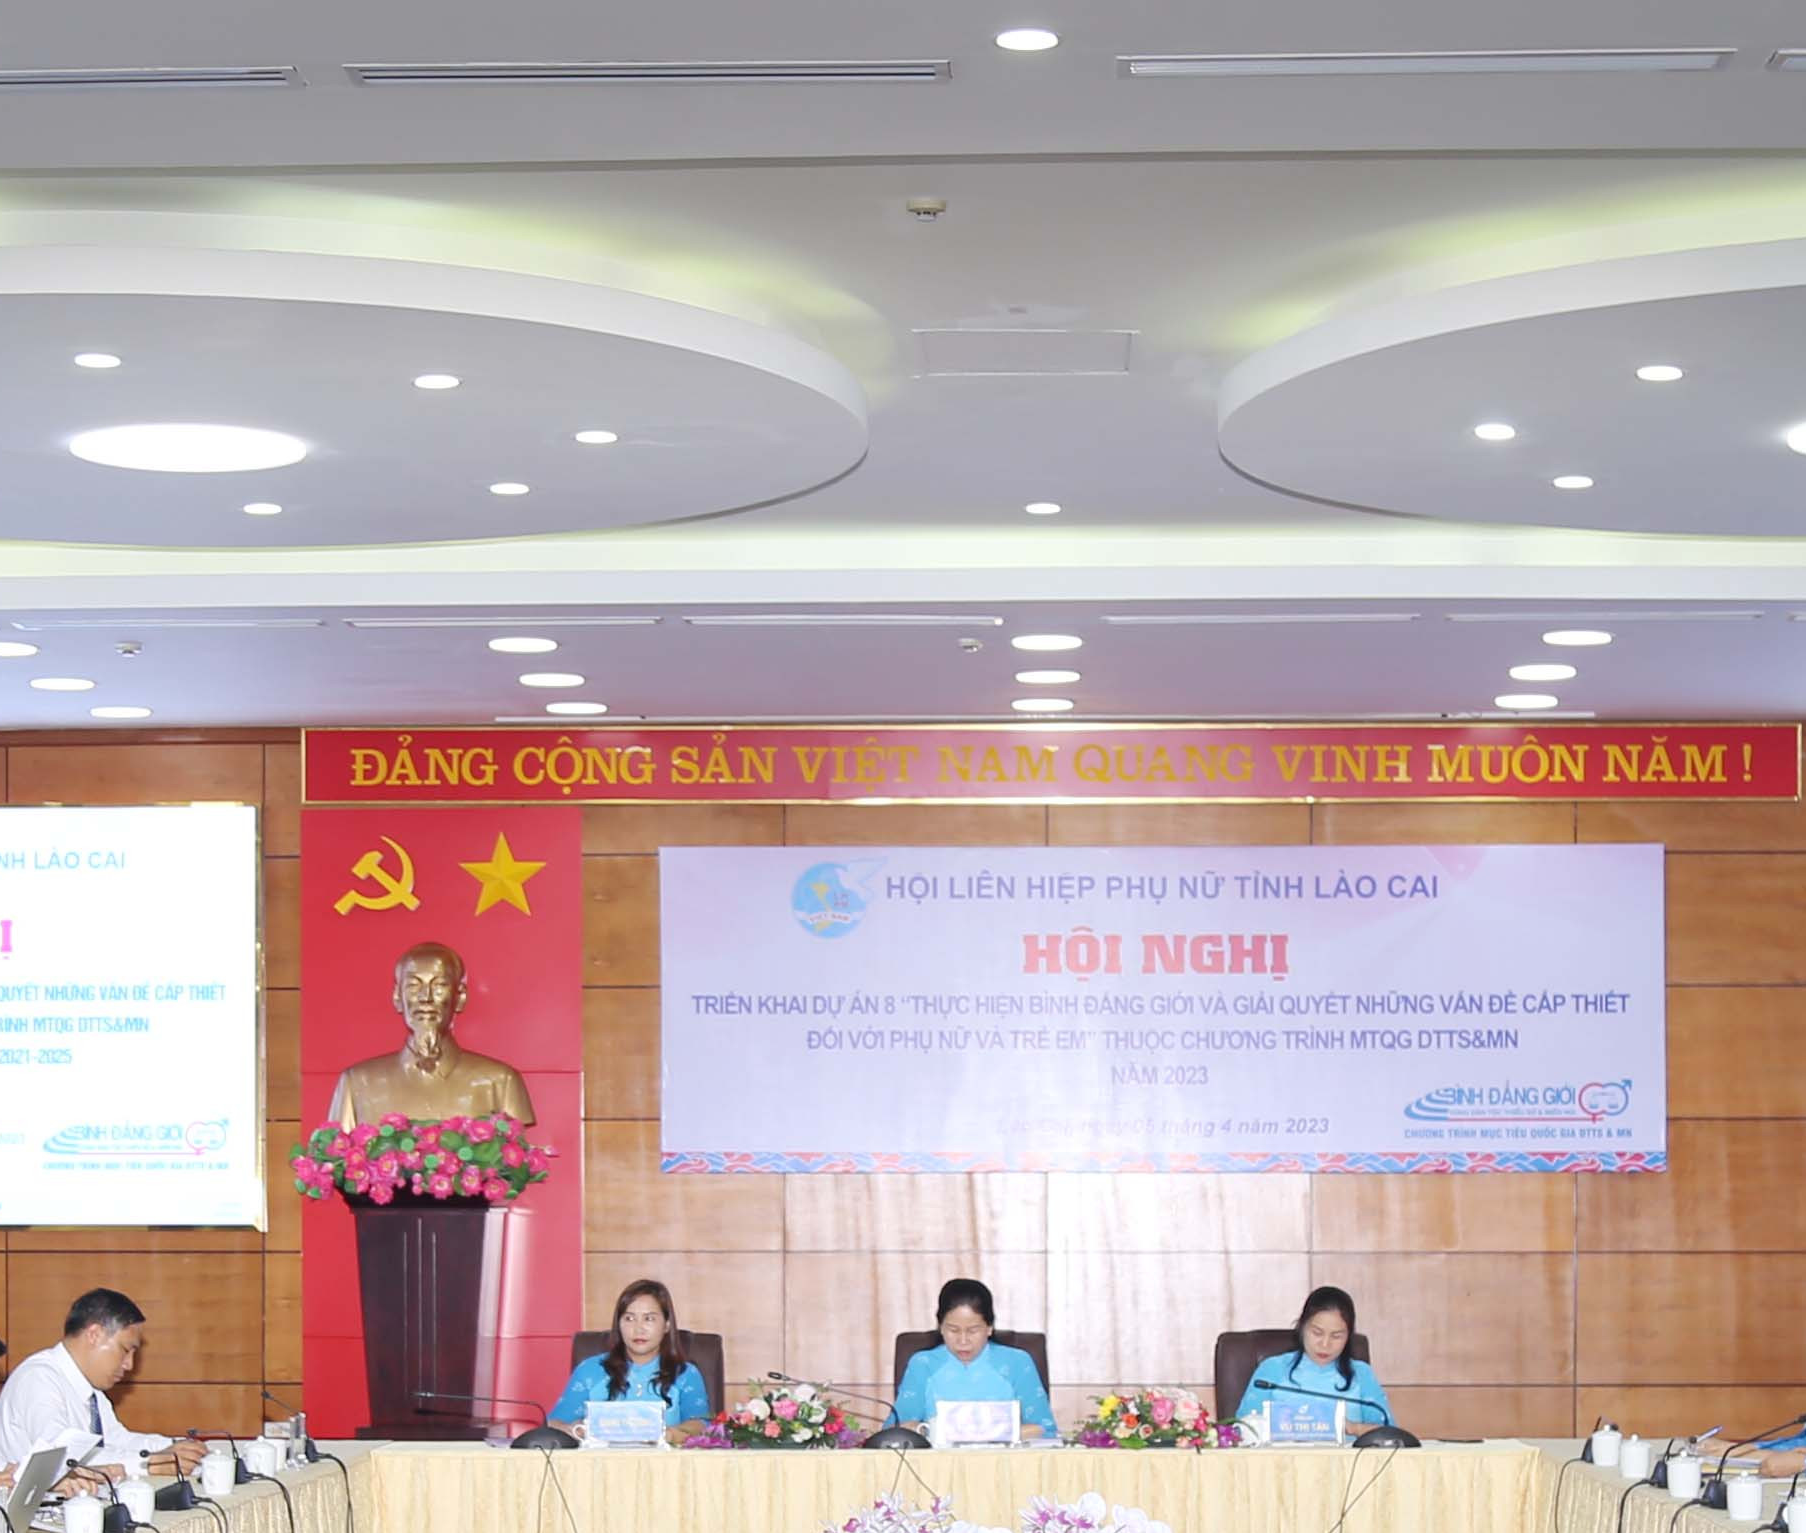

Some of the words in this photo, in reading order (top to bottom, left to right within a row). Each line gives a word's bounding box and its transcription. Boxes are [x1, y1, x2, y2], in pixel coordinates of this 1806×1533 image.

[350, 734, 498, 787] ĐẢNG
[513, 737, 657, 796] CỘNG
[672, 733, 775, 785] SẢN
[792, 737, 923, 794] VIỆT
[937, 745, 1062, 786] NAM
[1073, 744, 1253, 785] QUANG
[1273, 743, 1411, 784] VINH
[1426, 735, 1589, 784] MUÔN
[1602, 734, 1728, 783] NĂM
[88, 851, 125, 870] CAI
[887, 872, 937, 904] HỘI
[949, 870, 1015, 898] LIÊN
[1026, 872, 1095, 905] HIỆP
[1106, 876, 1167, 905] PHỤ
[1179, 870, 1225, 899] NỮ
[1234, 869, 1303, 899] TỈNH
[1315, 869, 1376, 899] LÀO
[1387, 875, 1438, 899] CAI
[1022, 925, 1122, 982] HỘI
[1142, 934, 1289, 981] NGHỊ
[758, 995, 807, 1015] KHAI
[849, 990, 878, 1015] ÁN
[884, 995, 895, 1015] 8
[1200, 990, 1228, 1015] VÀ
[1233, 990, 1274, 1015] GIẢI
[1356, 990, 1434, 1014] NHỮNG
[890, 1030, 932, 1054] PHỤ
[939, 1025, 971, 1050] NỮ
[976, 1025, 1004, 1050] VÀ
[1181, 1029, 1276, 1050] CHƯƠNG
[1282, 1025, 1344, 1050] TRÌNH
[1350, 1029, 1412, 1051] MTQG
[1418, 1029, 1519, 1050] DTTS&MN
[1111, 1061, 1157, 1085] NĂM
[1163, 1065, 1209, 1085] 2023
[1161, 1116, 1215, 1138] tháng
[1220, 1118, 1232, 1134] 4
[1237, 1116, 1279, 1134] năm
[1285, 1118, 1329, 1134] 2023
